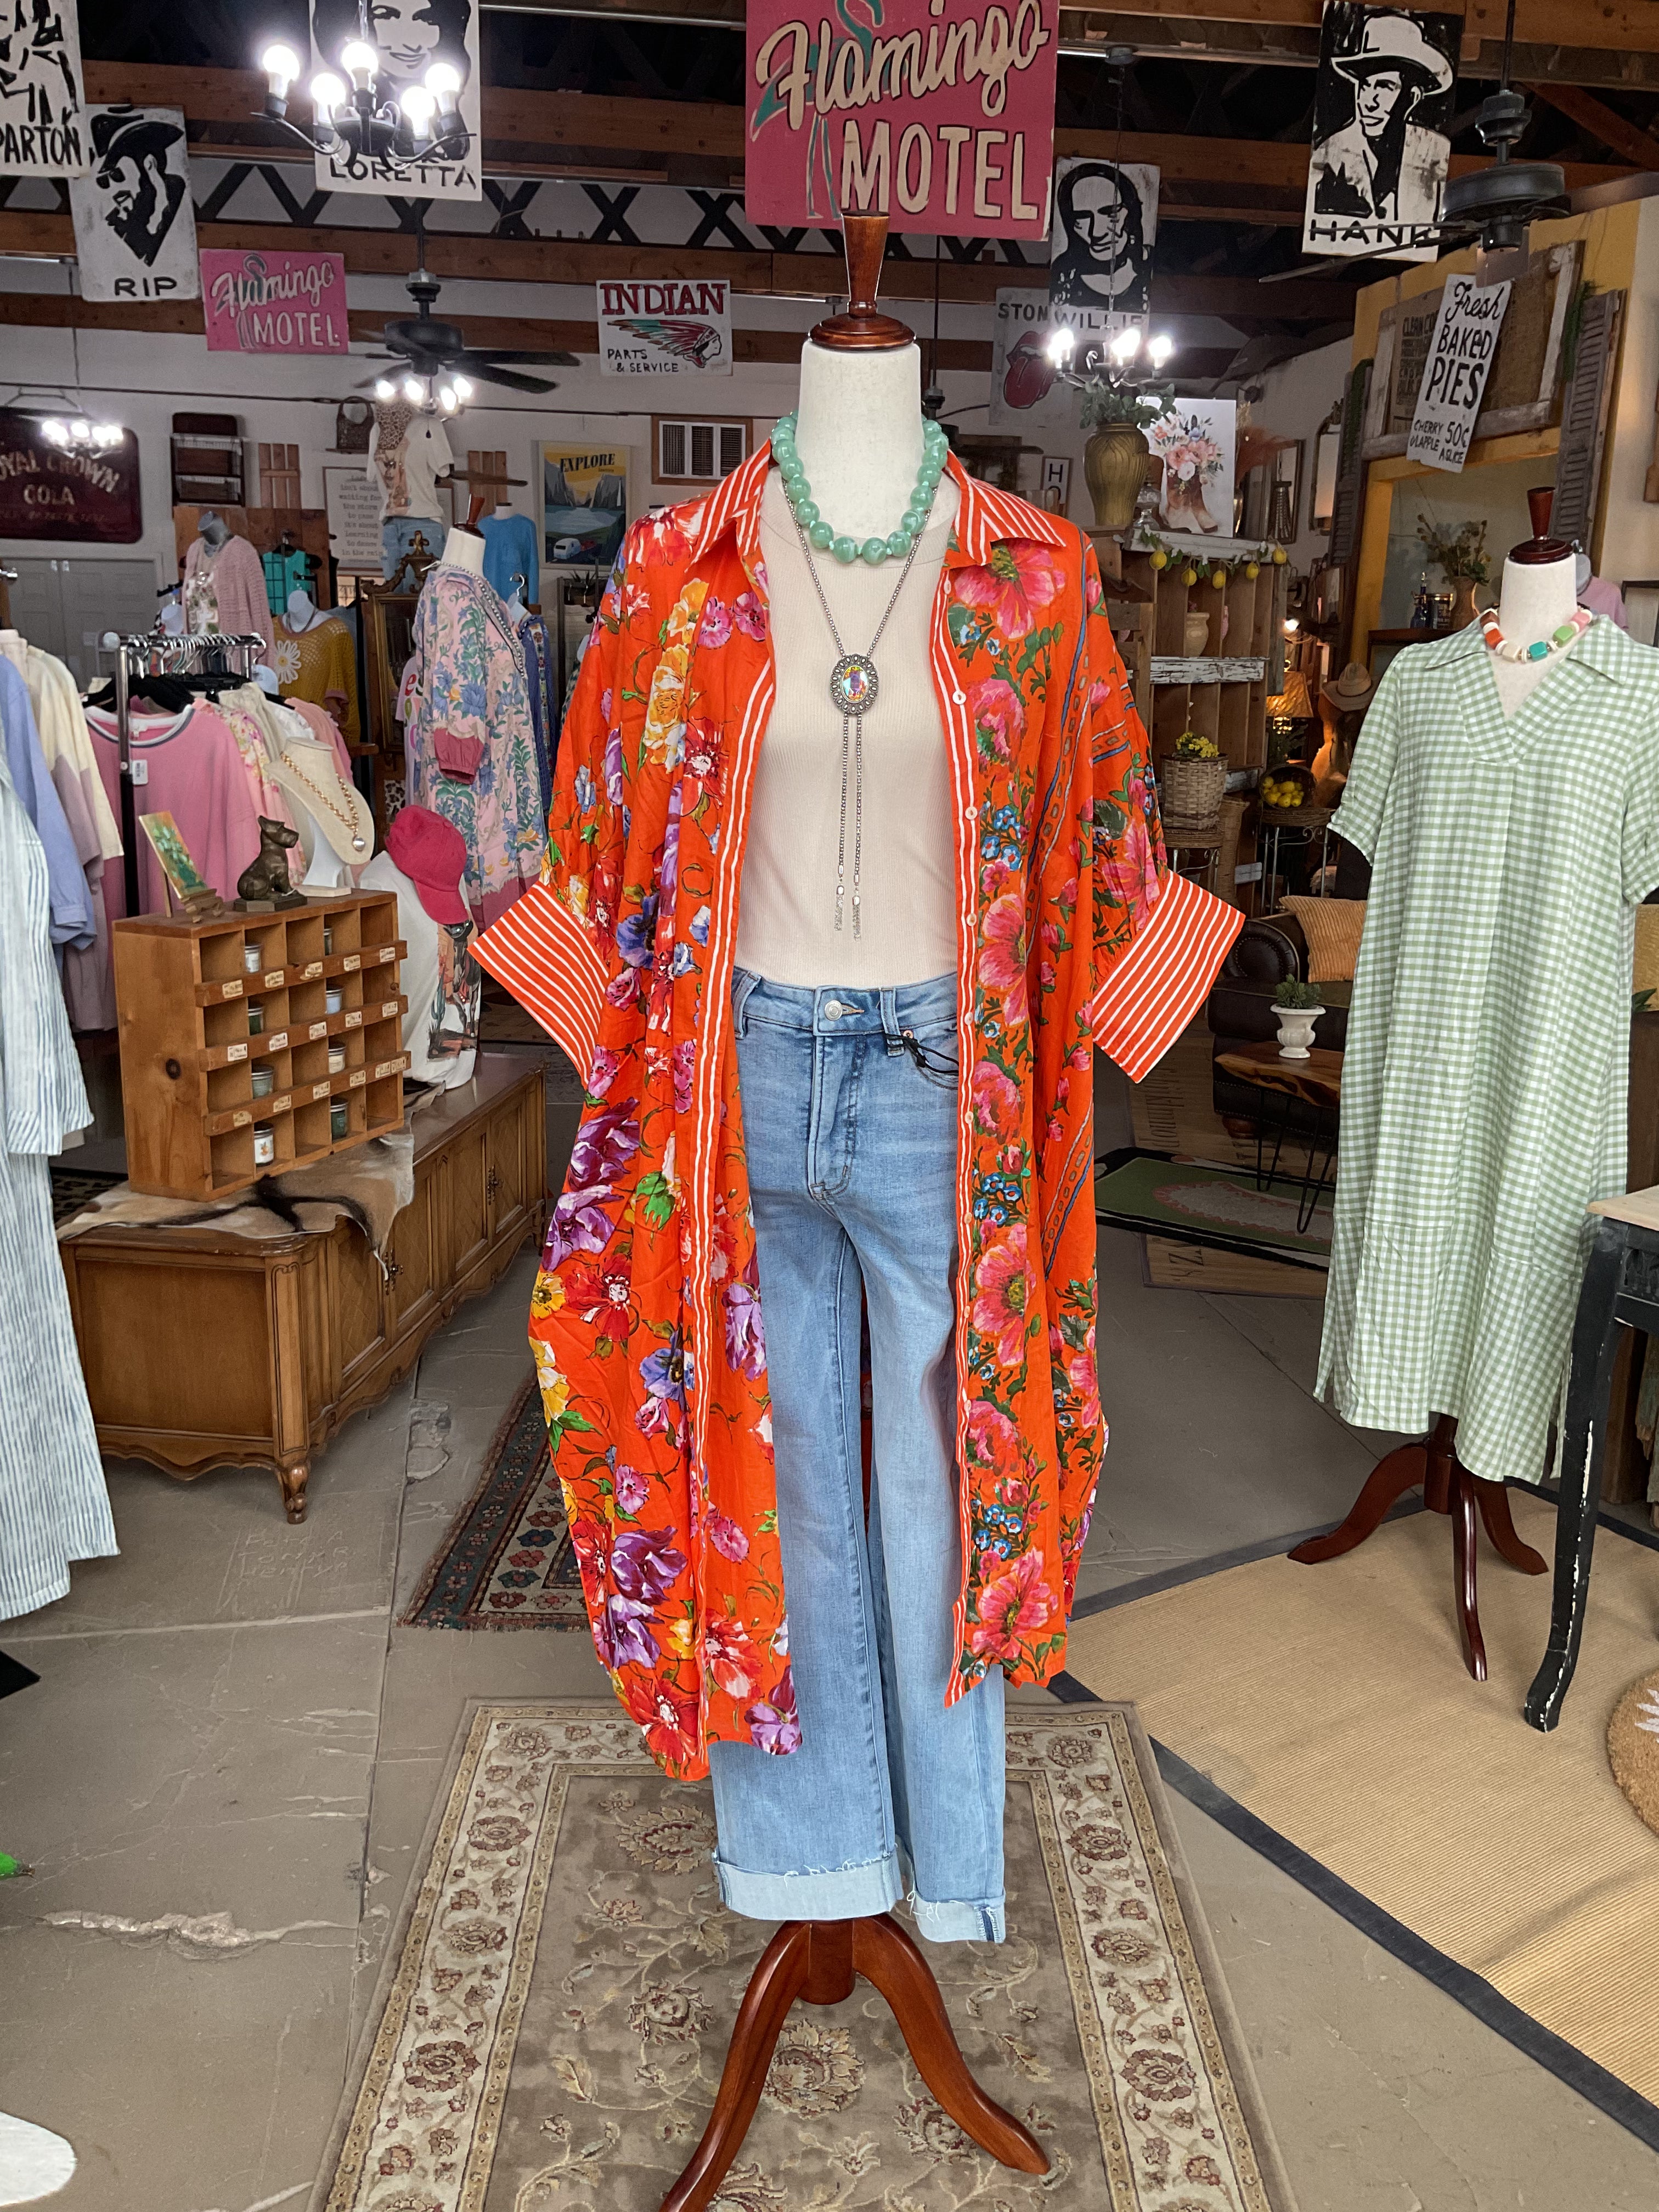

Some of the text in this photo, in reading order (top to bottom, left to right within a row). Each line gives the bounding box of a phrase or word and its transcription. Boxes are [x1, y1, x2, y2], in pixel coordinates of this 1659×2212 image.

[755, 0, 1051, 131] Flamingo
[330, 157, 477, 190] LORETTA
[840, 119, 1040, 220] MOTEL
[1309, 219, 1432, 246] HANK
[114, 276, 177, 297] RIP
[211, 261, 335, 318] Flamingo
[600, 283, 727, 315] INDIAN
[1444, 281, 1505, 323] Fresh
[253, 312, 340, 347] MOTEL
[1436, 324, 1493, 360] BAKED
[607, 348, 648, 360] PARTS
[616, 363, 679, 373] & SERVICE
[1425, 357, 1485, 410] PIES
[1414, 419, 1444, 436] CHERRY
[560, 453, 615, 472] EXPLORE
[24, 484, 76, 506] COLA
